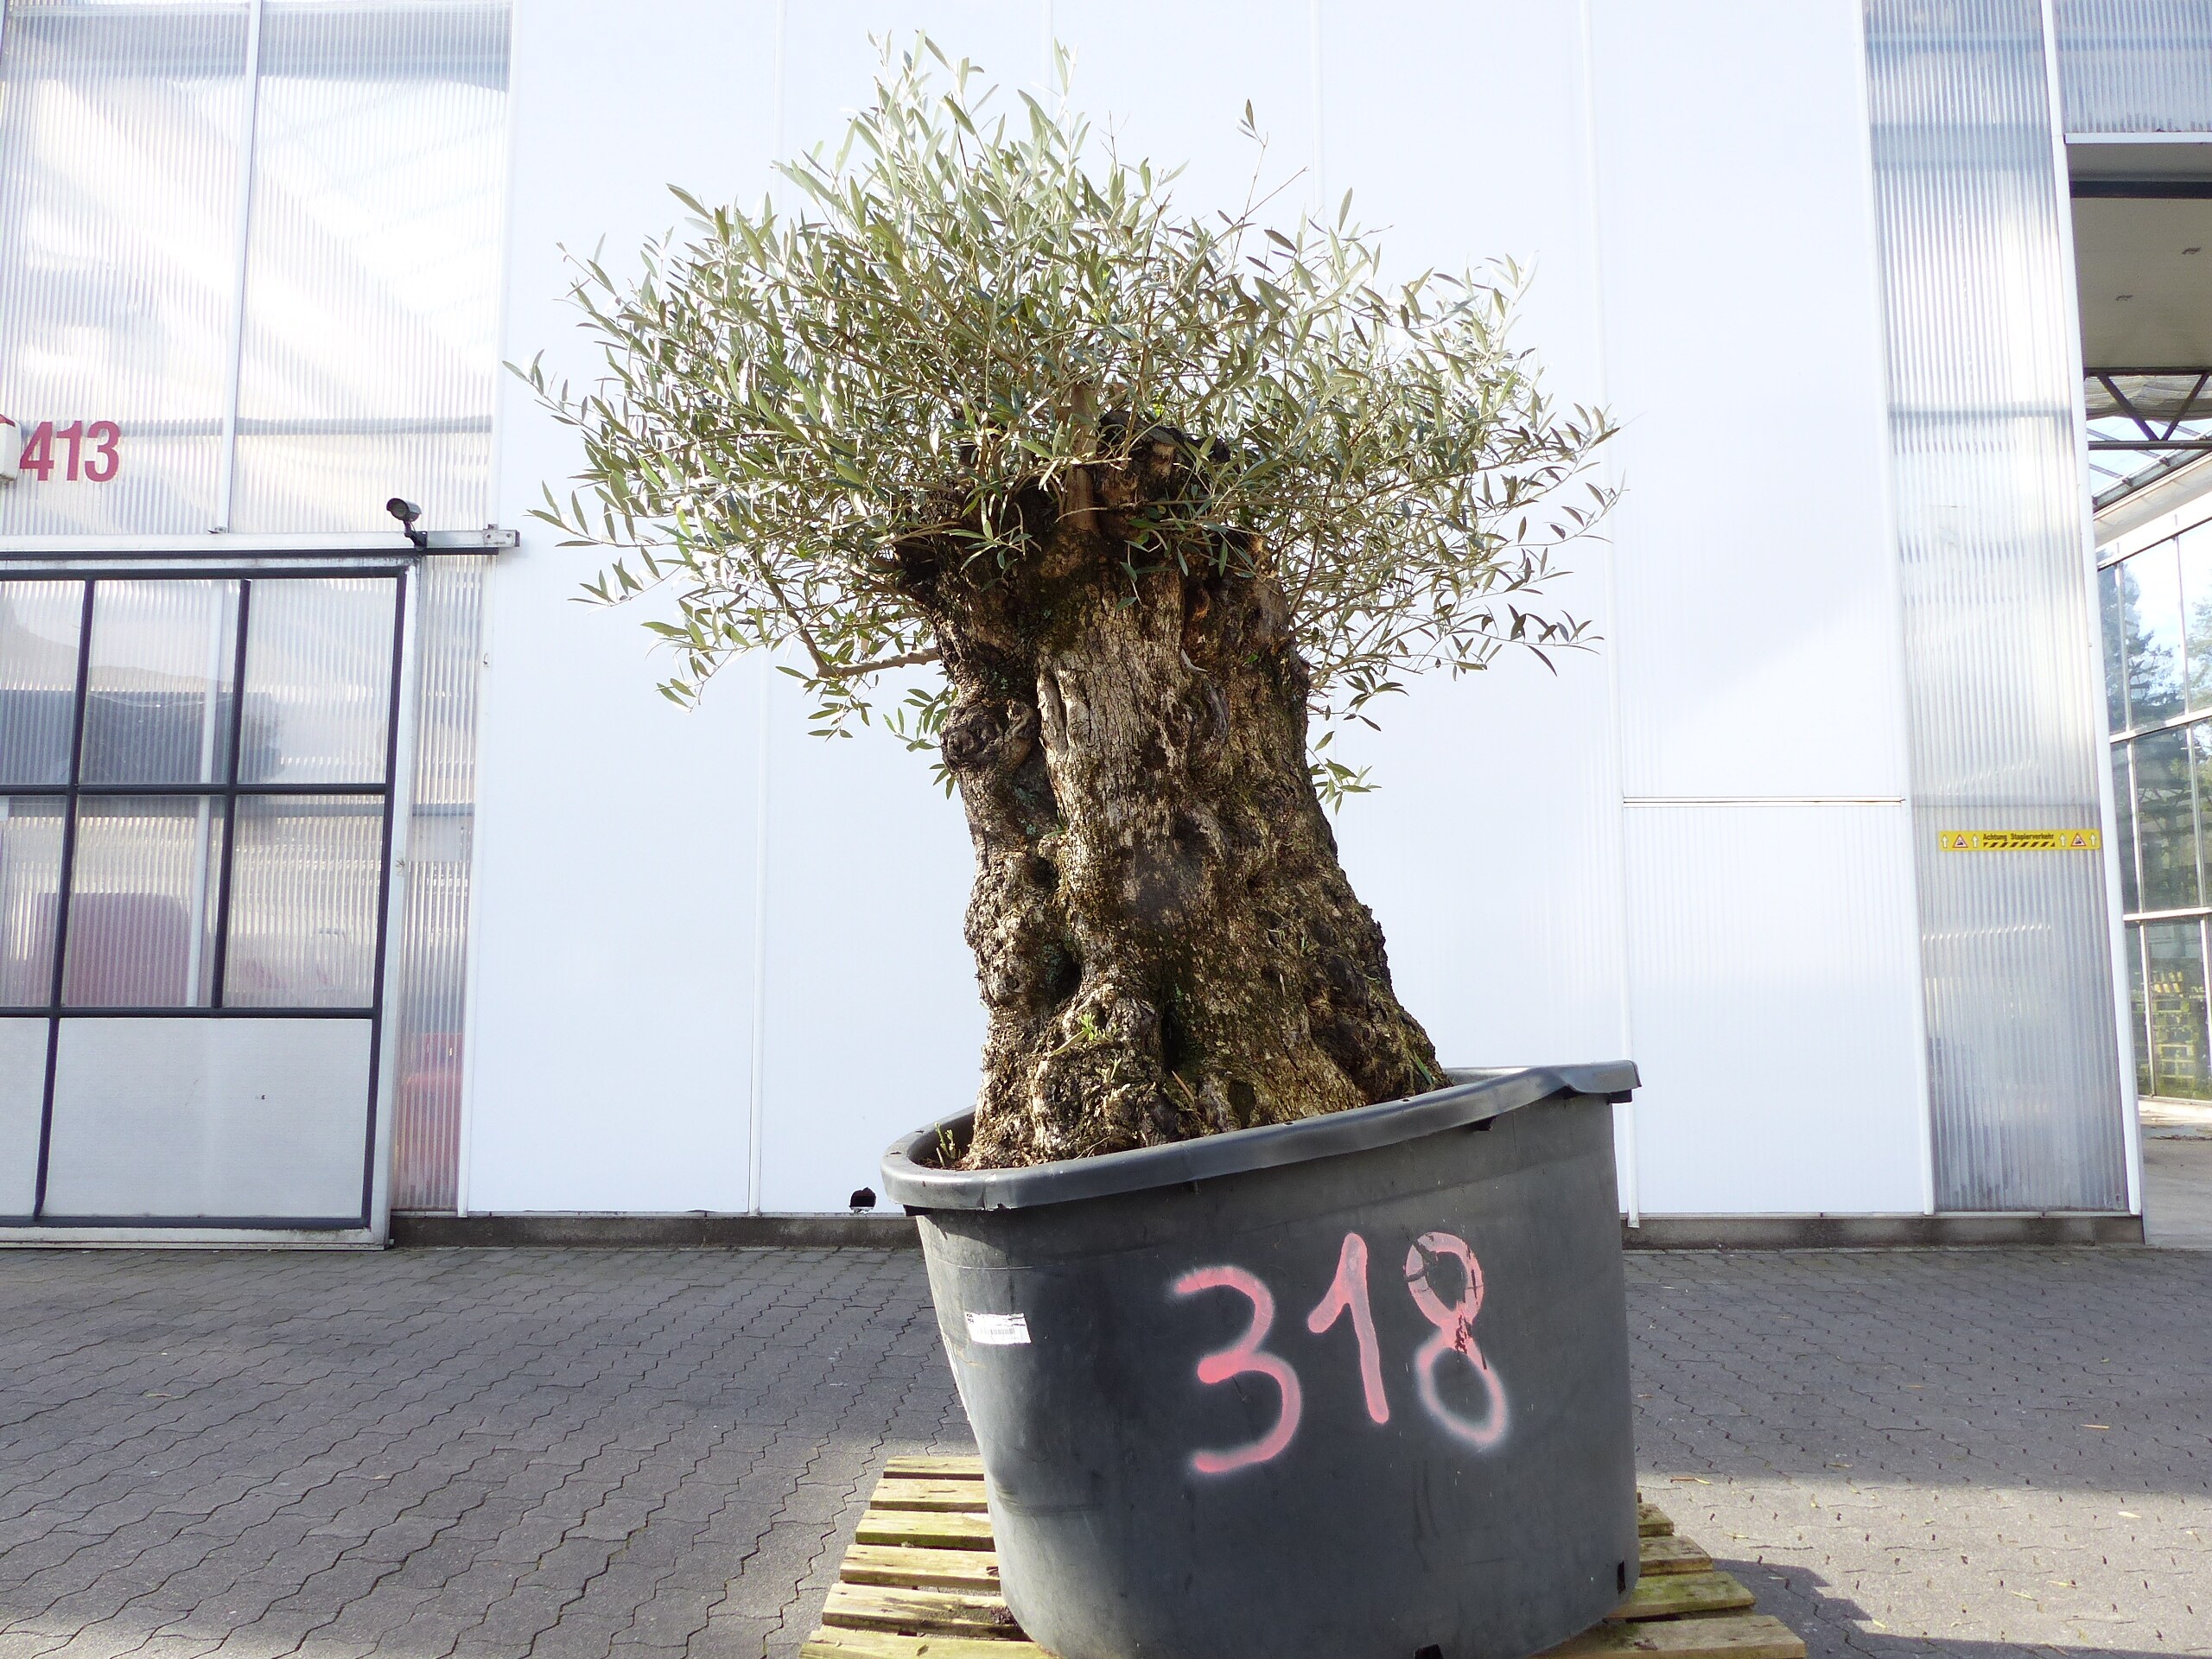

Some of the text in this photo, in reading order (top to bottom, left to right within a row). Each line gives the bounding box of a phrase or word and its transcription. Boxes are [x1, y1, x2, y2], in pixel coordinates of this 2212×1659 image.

[19, 420, 121, 482] 413
[1982, 833, 2055, 842] Achtung Staplerverkehr
[1173, 1230, 1510, 1475] 318
